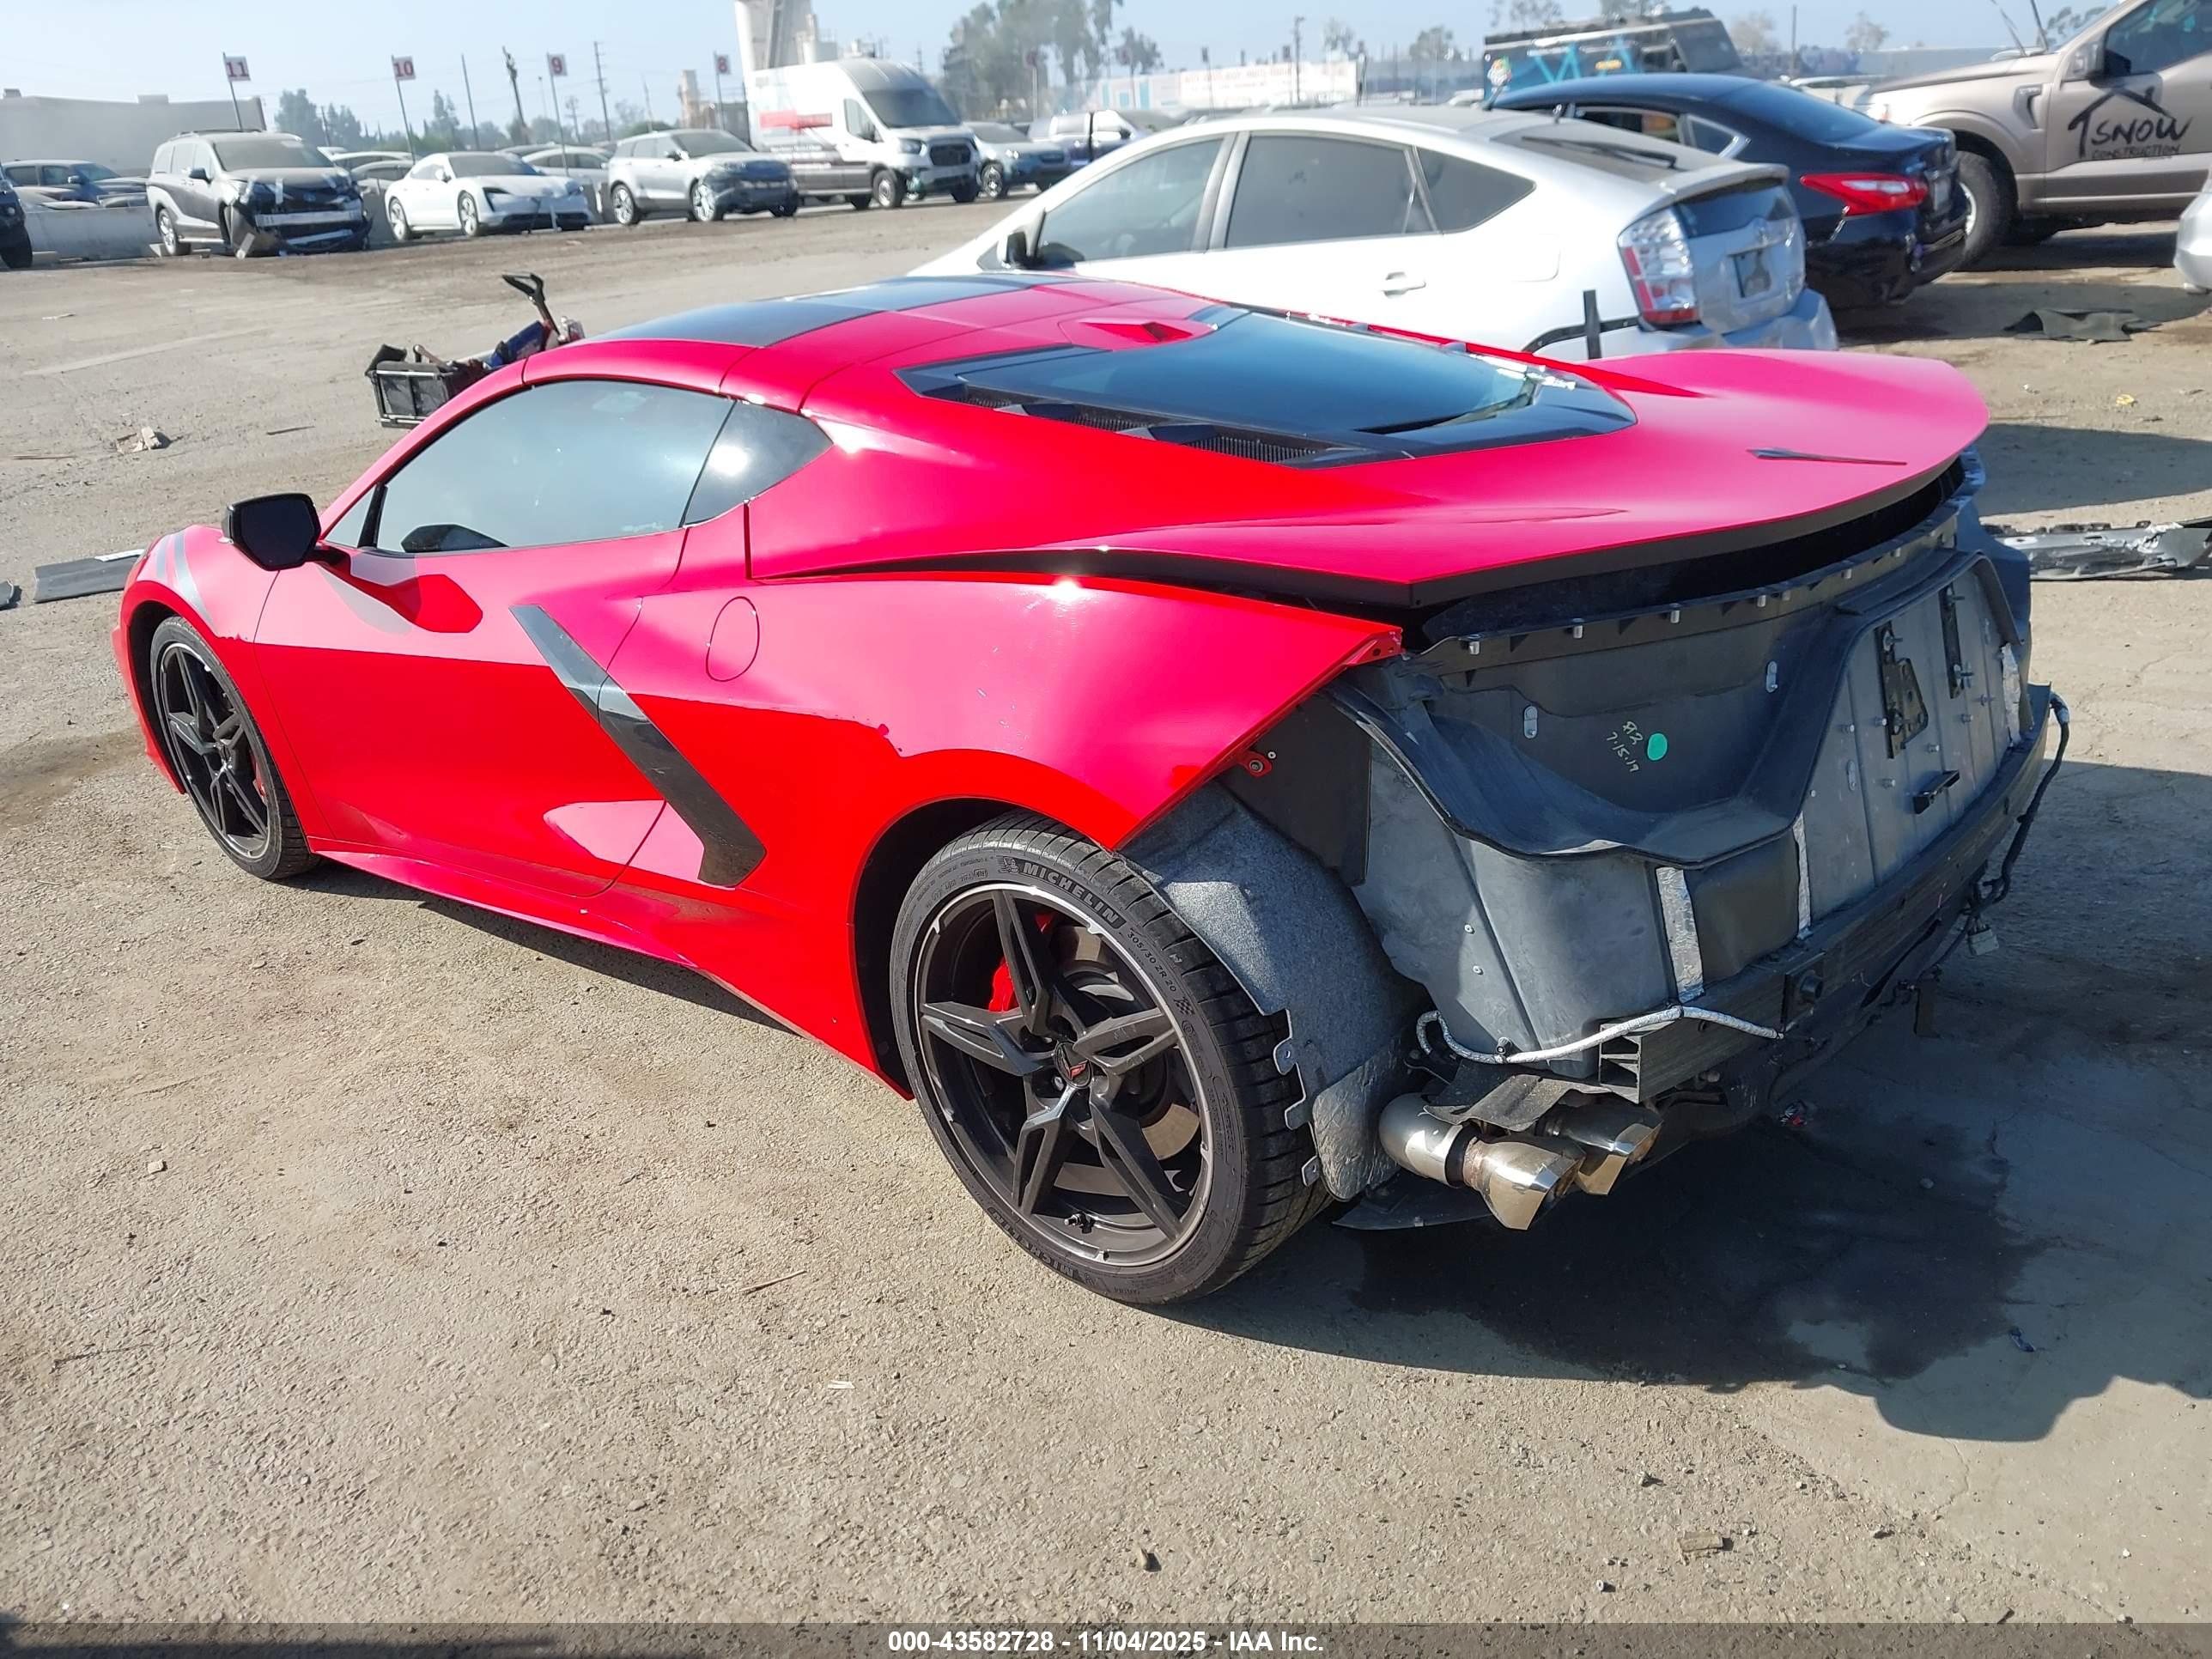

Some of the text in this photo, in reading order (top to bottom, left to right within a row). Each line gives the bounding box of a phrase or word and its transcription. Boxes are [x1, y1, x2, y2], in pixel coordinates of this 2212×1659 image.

[227, 60, 249, 78] 11
[393, 61, 415, 78] 10
[551, 57, 564, 74] 9
[2092, 143, 2181, 160] CONSTRUCTION
[1023, 861, 1119, 925] MICHELIN
[1127, 931, 1156, 965] 305/30
[1154, 964, 1168, 979] ZR
[1165, 978, 1177, 993] 20
